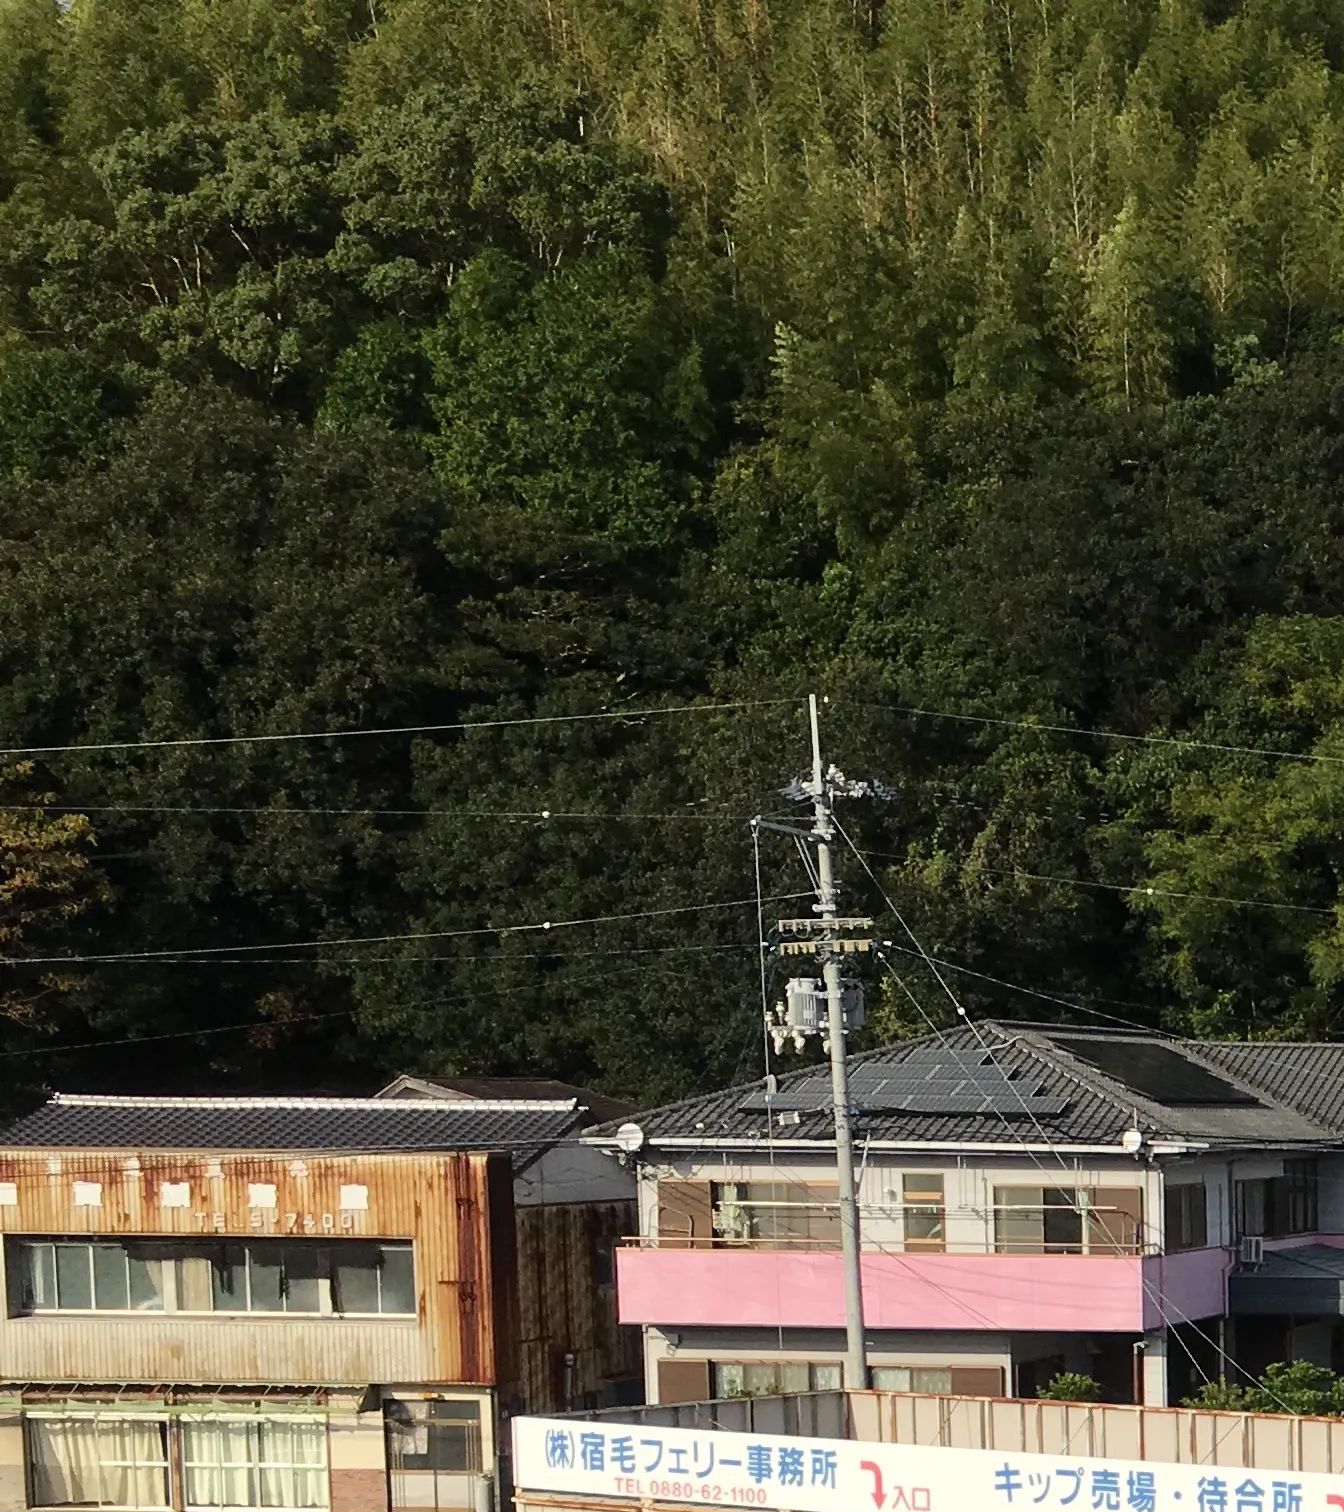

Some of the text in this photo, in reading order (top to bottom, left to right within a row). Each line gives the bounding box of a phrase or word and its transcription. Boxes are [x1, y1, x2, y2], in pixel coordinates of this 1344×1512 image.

[195, 1211, 246, 1229] TE
[545, 1428, 838, 1490] (株)宿毛フェリー事務所
[614, 1477, 768, 1505] TEL 0880-62-1100
[891, 1485, 931, 1512] 入口
